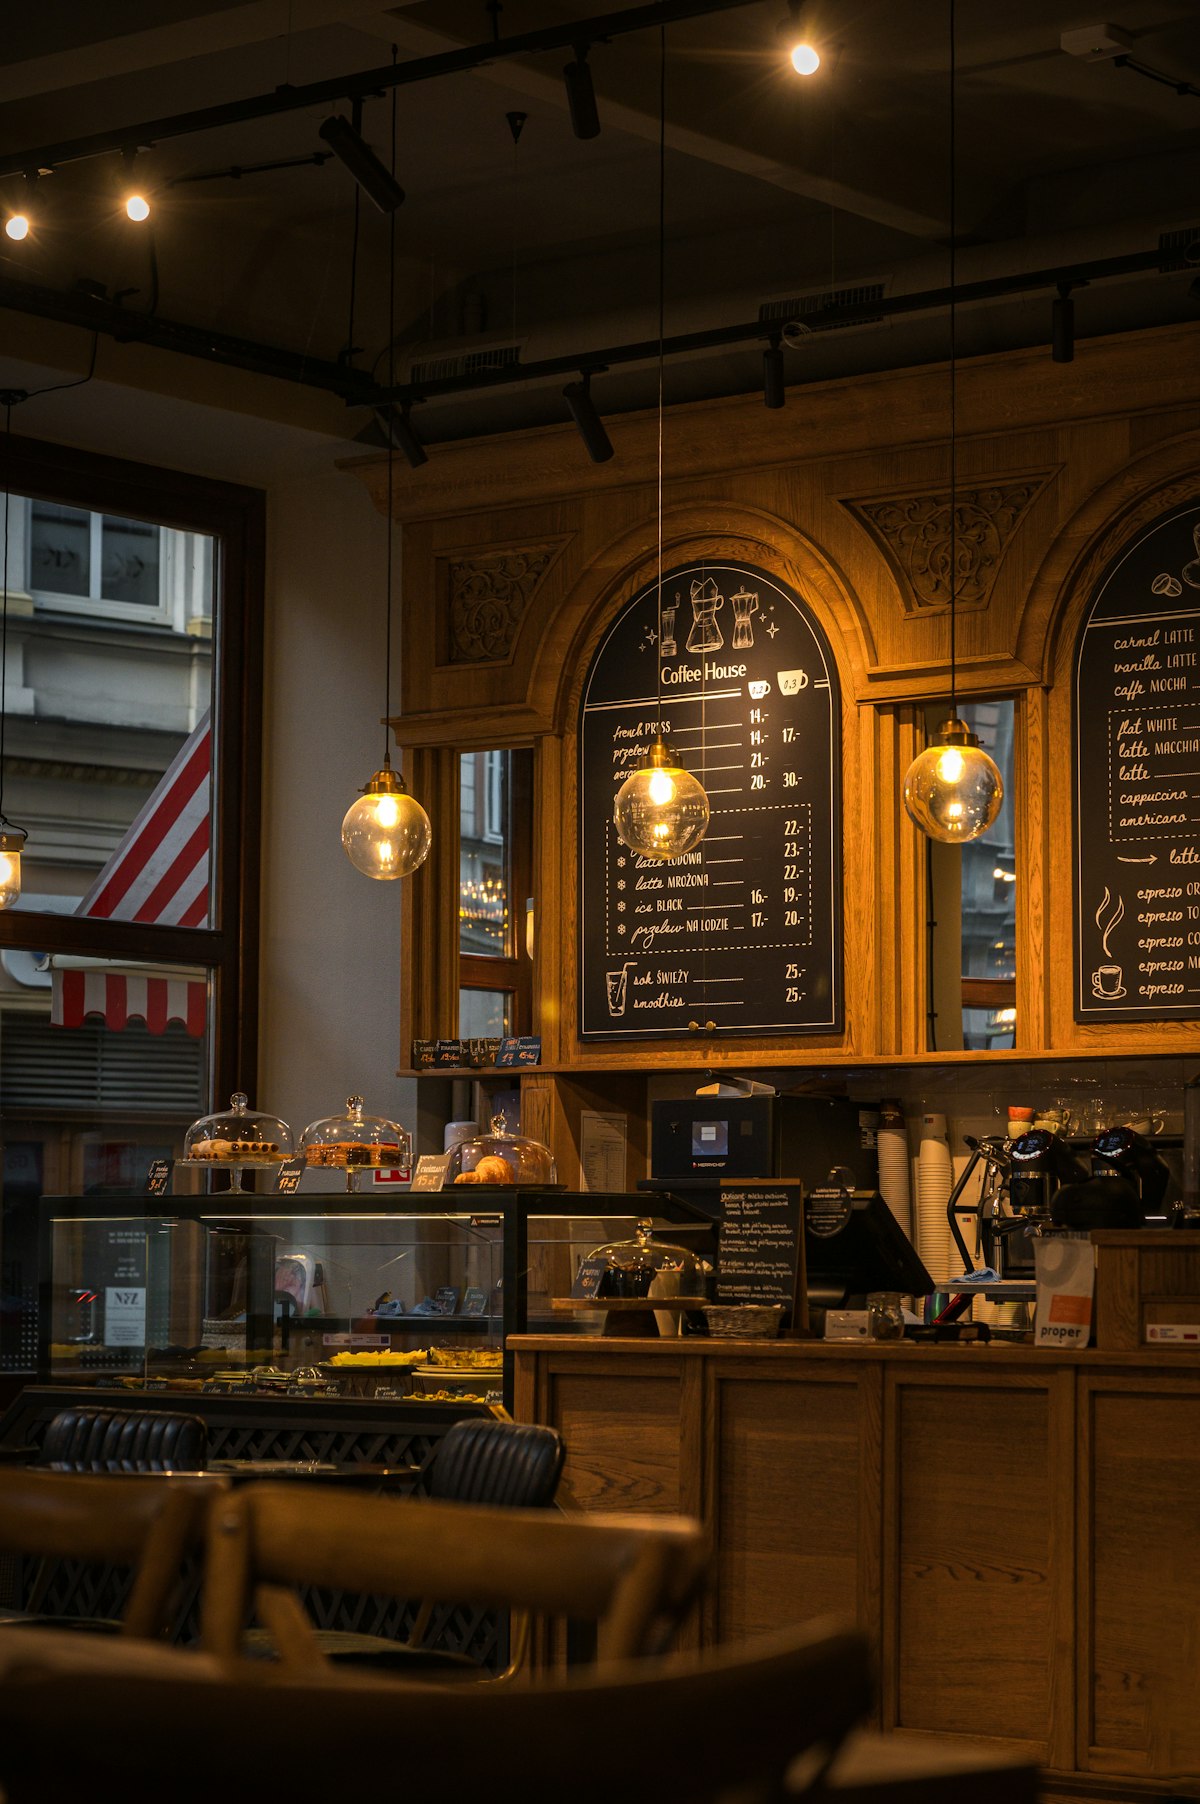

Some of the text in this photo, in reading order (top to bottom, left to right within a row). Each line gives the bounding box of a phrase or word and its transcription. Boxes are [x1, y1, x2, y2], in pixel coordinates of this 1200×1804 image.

[1114, 628, 1194, 650] carmel LATTE
[1114, 652, 1197, 673] vanilla LATTE
[660, 663, 747, 685] Coffee House
[1150, 676, 1186, 693] MOCHA
[612, 722, 644, 742] french
[750, 708, 770, 724] 14,-
[1116, 717, 1178, 741] flat WHITE
[750, 730, 769, 746] 14,-
[782, 728, 801, 744] 17,-
[1119, 738, 1200, 758] latte MACCHIA
[750, 752, 770, 768] 21,-
[1119, 763, 1151, 781] latte
[750, 772, 803, 791] 20,- 30,-
[1120, 788, 1188, 806] cappuccino
[784, 820, 804, 836] 22,-
[1120, 812, 1188, 827] americano
[784, 842, 804, 858] 23,-
[1169, 846, 1200, 864] latte
[634, 864, 804, 891] latte MROŻONA 22,-
[634, 887, 803, 914] ice BLACK 16,- 19,-
[1136, 887, 1183, 904] espresso
[1137, 910, 1184, 928] espresso
[630, 910, 805, 950] przelew NA LODZIE 17,- 20,-
[1138, 936, 1184, 954] espresso
[632, 964, 807, 986] sok ŚWIEŻY 25,-
[1138, 956, 1200, 977] espresso M
[632, 987, 807, 1010] smoothies 25,-
[1138, 983, 1184, 1000] espresso
[1040, 1326, 1082, 1340] proper
